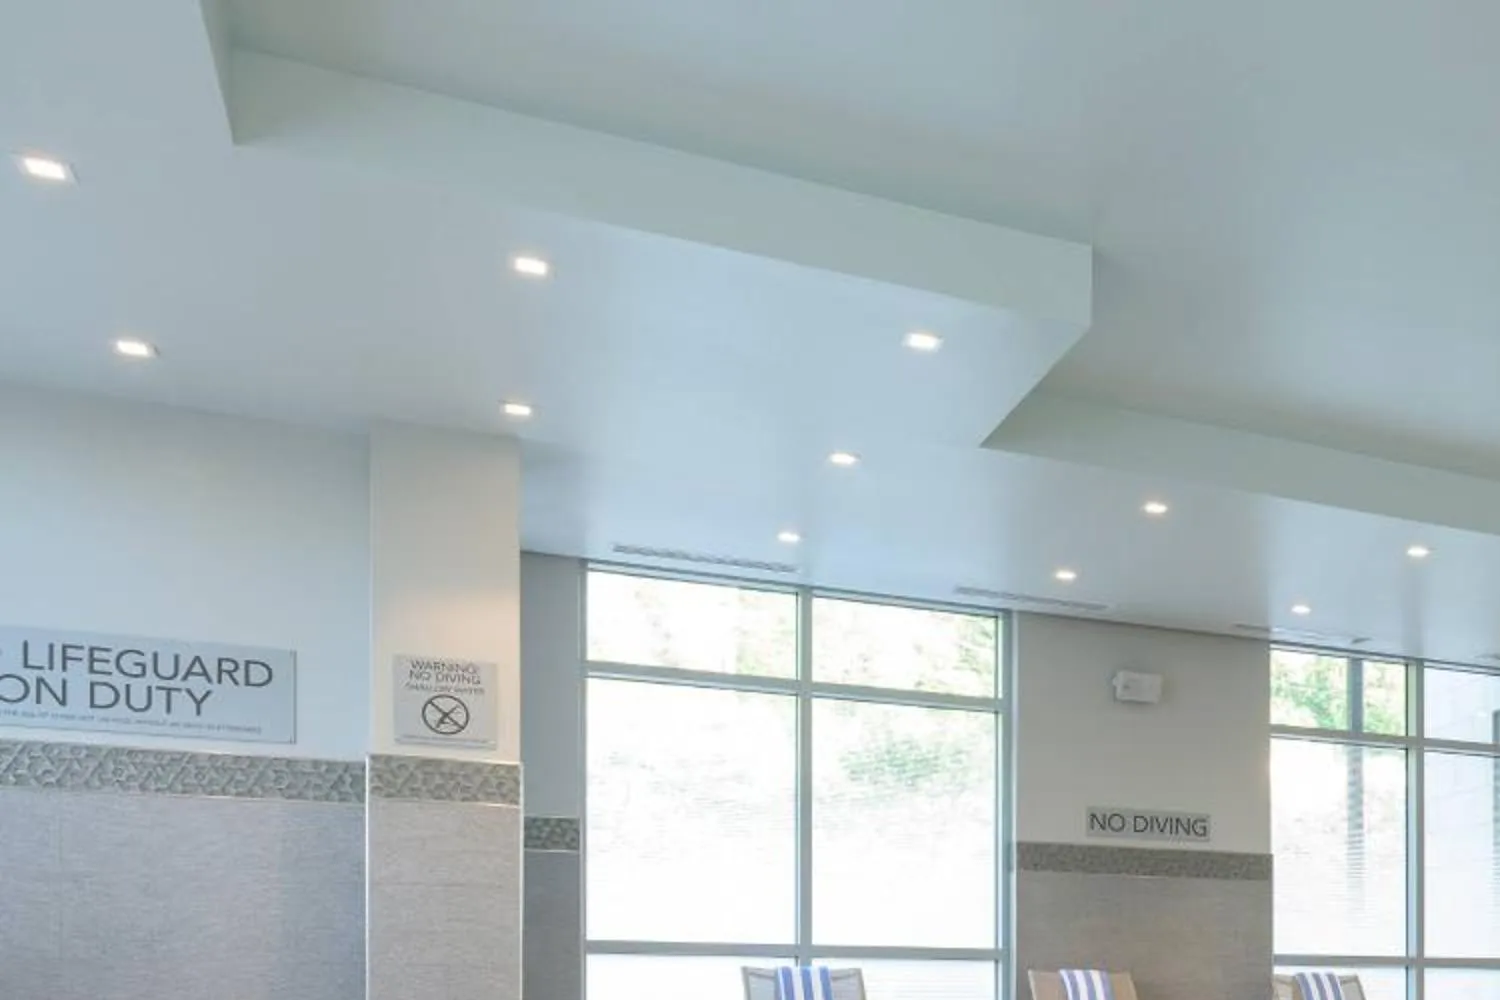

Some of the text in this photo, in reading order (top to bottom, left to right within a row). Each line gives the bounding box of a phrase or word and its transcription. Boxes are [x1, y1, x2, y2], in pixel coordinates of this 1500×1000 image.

[22, 640, 273, 688] LIFEGUARD
[408, 669, 481, 684] NO DIVING
[0, 673, 213, 716] ON DUTY
[1090, 813, 1207, 838] NO DIVING
